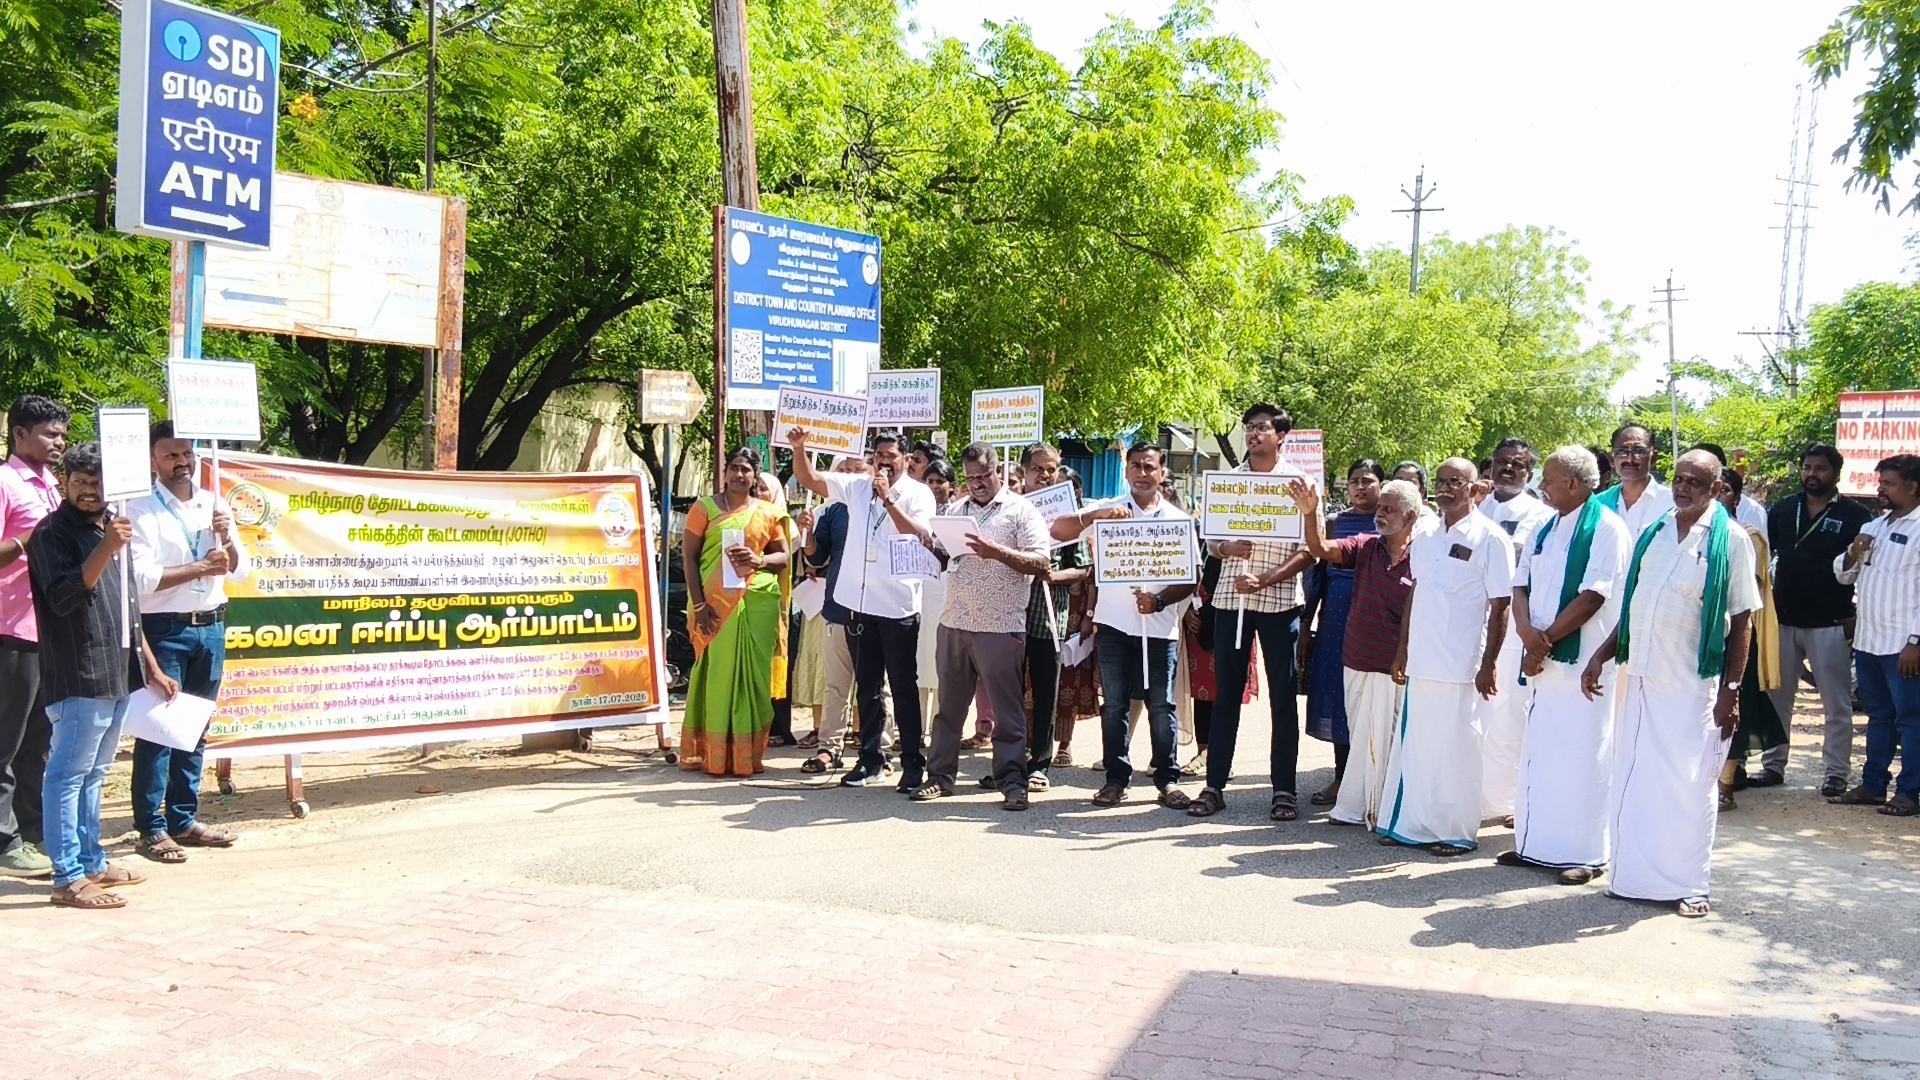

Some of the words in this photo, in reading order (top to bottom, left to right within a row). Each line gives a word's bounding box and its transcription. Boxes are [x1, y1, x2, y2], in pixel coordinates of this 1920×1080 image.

[208, 35, 265, 81] SBI
[162, 71, 264, 115] ஏடிஎம்
[161, 117, 261, 164] एटीएम
[159, 161, 261, 212] ATM
[733, 291, 764, 306] DISTRICT
[765, 294, 783, 309] TOWN
[784, 297, 798, 310] AND
[798, 298, 827, 315] COUNTRY
[827, 302, 856, 319] PLANNING
[857, 306, 877, 322] OFFICE
[768, 315, 820, 331] VIRUDHUNAGAR
[820, 321, 848, 334] DISTRICT
[1838, 421, 1858, 440] NO
[1863, 421, 1920, 441] PARKIN
[1285, 444, 1322, 454] PARKING
[288, 490, 364, 515] தமிழ்நாடு
[348, 523, 424, 547] சங்கத்தின்
[427, 525, 503, 547] கூட்டமைப்பு
[265, 554, 298, 569] அரசின்
[258, 575, 316, 593] உழவர்களை
[352, 577, 378, 591] கூடிய
[323, 595, 406, 612] மாநிலம்
[410, 594, 487, 611] தழுவிய
[489, 591, 575, 606] மாபெரும்
[223, 622, 342, 649] கவன
[351, 609, 447, 648] ஈர்ப்பு
[456, 601, 637, 645] ஆர்ப்பாட்டம்
[599, 692, 647, 705] 17.07.2026
[210, 720, 241, 735] இடம்
